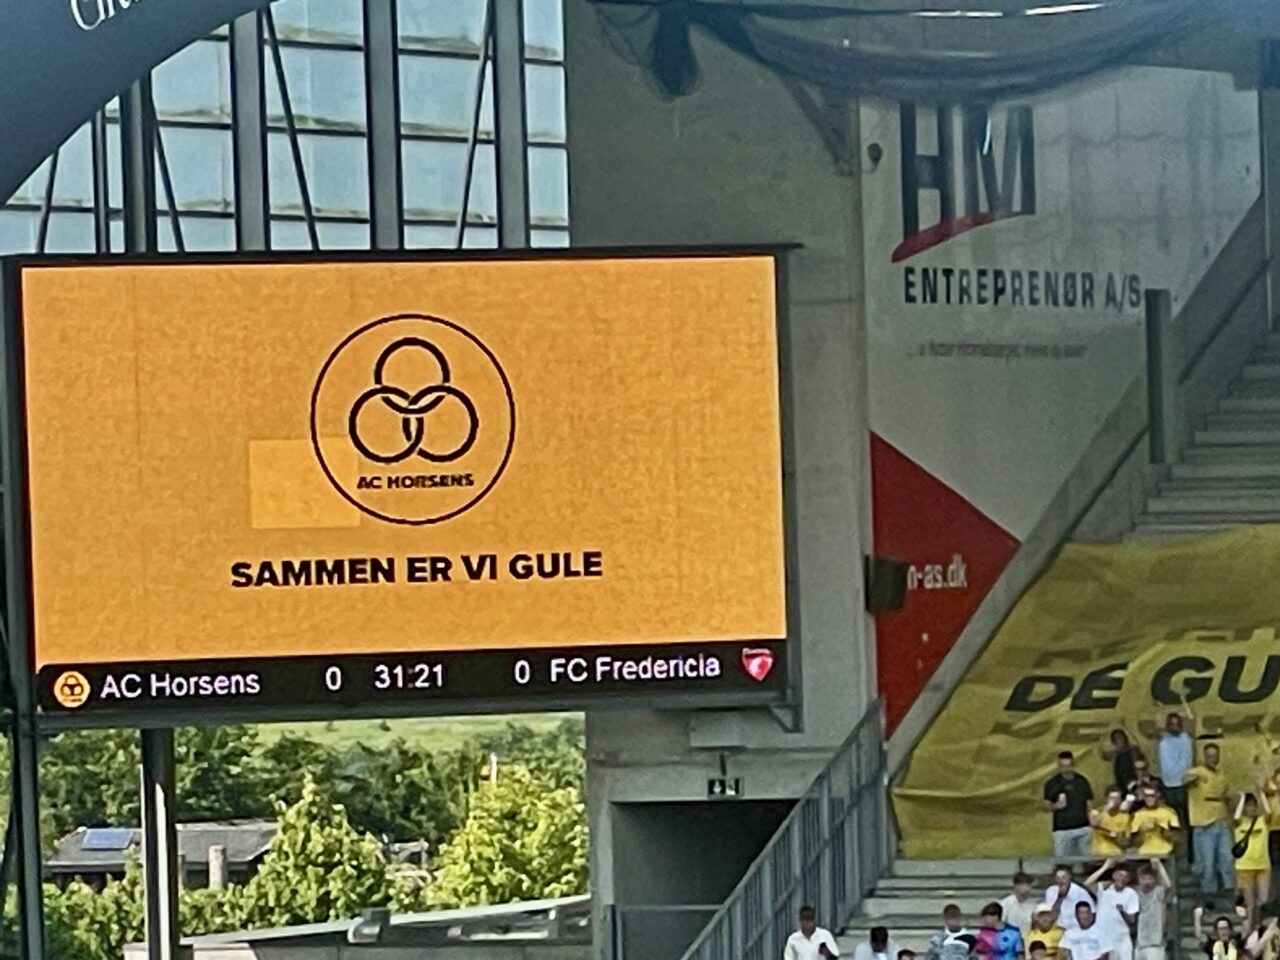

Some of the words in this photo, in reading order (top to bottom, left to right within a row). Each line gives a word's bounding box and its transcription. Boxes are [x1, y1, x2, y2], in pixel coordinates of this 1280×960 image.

[904, 266, 1094, 308] ENTREPRENØR
[1105, 272, 1144, 313] A/S
[357, 475, 382, 490] AC
[387, 473, 475, 489] HORSENS
[231, 557, 395, 588] SAMMEN
[406, 556, 453, 583] ER
[460, 554, 497, 581] VI
[508, 551, 603, 580] GULE
[325, 666, 342, 691] 0
[374, 663, 444, 689] 31:21
[514, 660, 531, 684] 0
[550, 658, 588, 683] FC
[595, 653, 721, 682] Fredericia
[100, 674, 142, 699] AC
[150, 671, 261, 697] Horsens
[1004, 660, 1129, 712] DE
